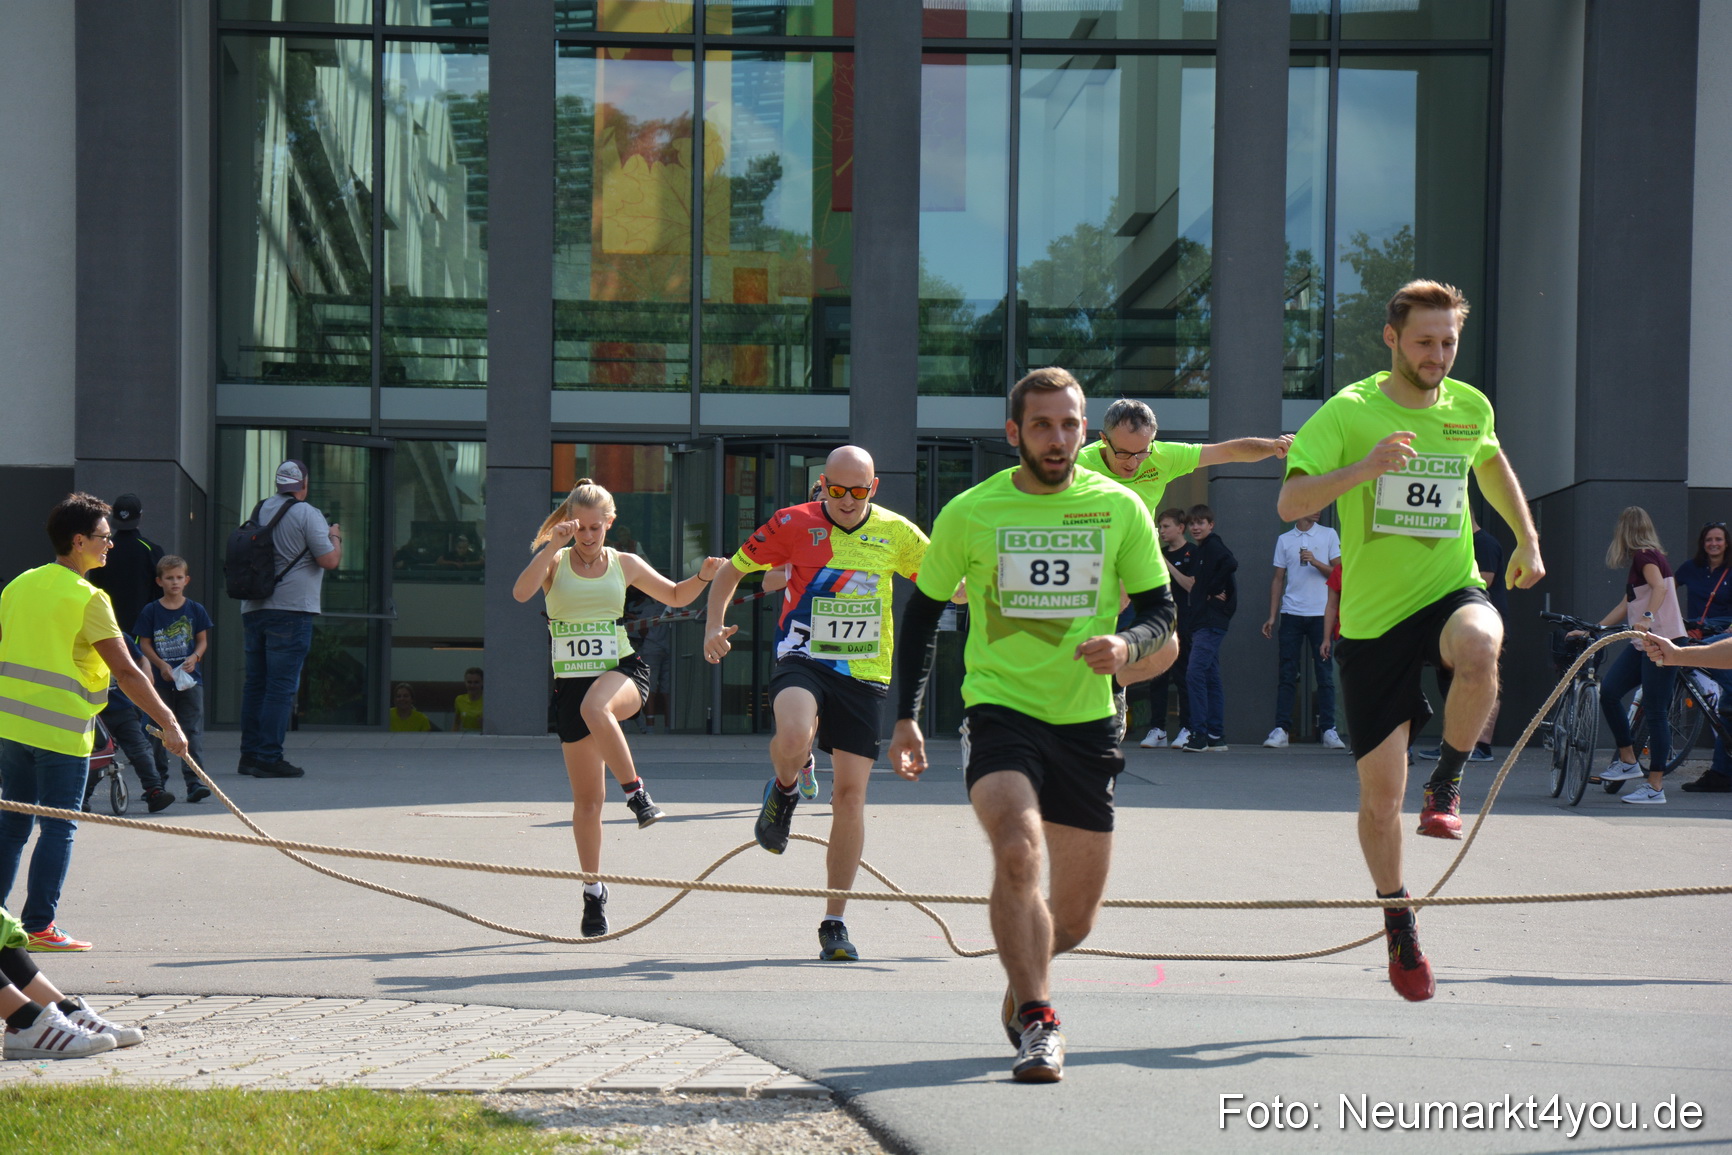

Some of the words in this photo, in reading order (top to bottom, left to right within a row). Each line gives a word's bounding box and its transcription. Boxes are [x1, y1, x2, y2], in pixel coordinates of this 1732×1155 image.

[1406, 482, 1442, 508] 84
[1394, 514, 1448, 527] PHILIPP
[1005, 531, 1096, 551] BOCK
[1030, 559, 1070, 586] 83
[817, 600, 876, 616] BOCK
[1009, 594, 1089, 607] JOHANNES
[556, 621, 611, 636] BOCK
[828, 620, 867, 639] 177
[566, 639, 603, 657] 103
[564, 662, 606, 671] DANIELA
